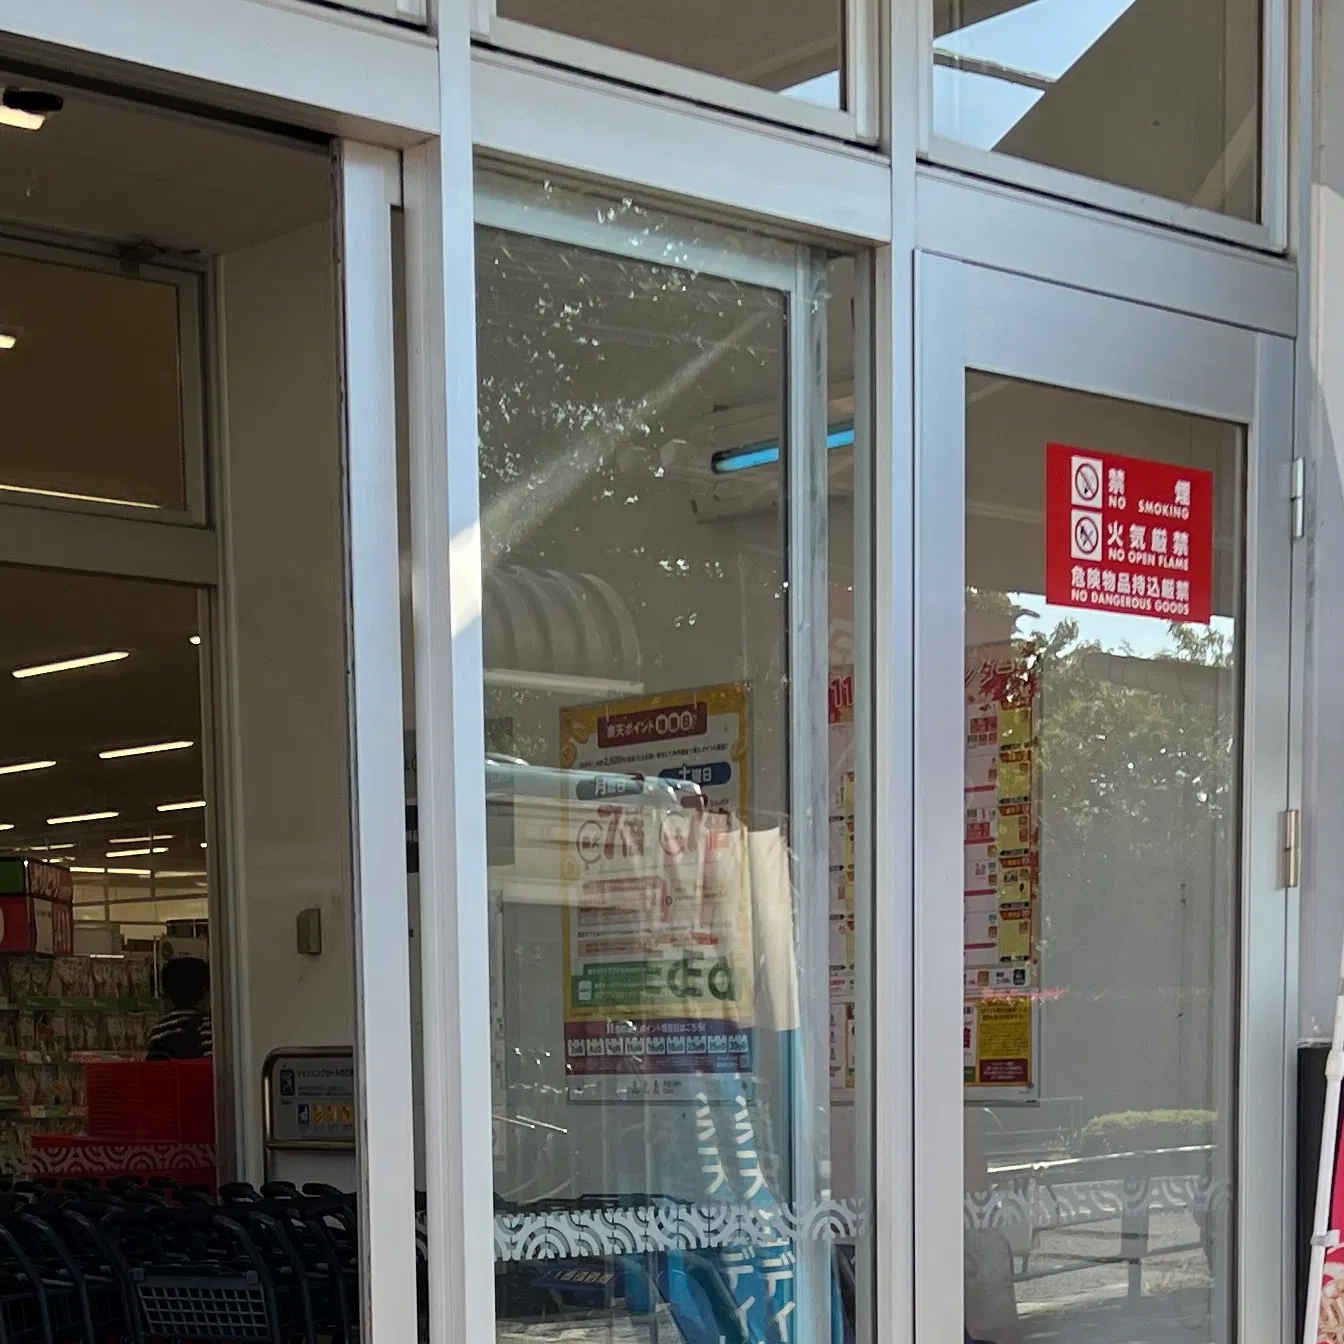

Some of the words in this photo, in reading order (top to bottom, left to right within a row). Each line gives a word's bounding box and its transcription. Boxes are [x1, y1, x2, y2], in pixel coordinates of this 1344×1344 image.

[1108, 495, 1127, 510] NO
[1138, 499, 1190, 521] SMOKING
[1107, 520, 1190, 557] 火気厳禁
[1108, 548, 1125, 563] NO
[1128, 549, 1156, 567] OPEN
[1158, 557, 1190, 572] FLAME
[1071, 588, 1088, 603] NO
[1091, 591, 1152, 612] DANGEROUS
[1155, 599, 1190, 616] GOODS
